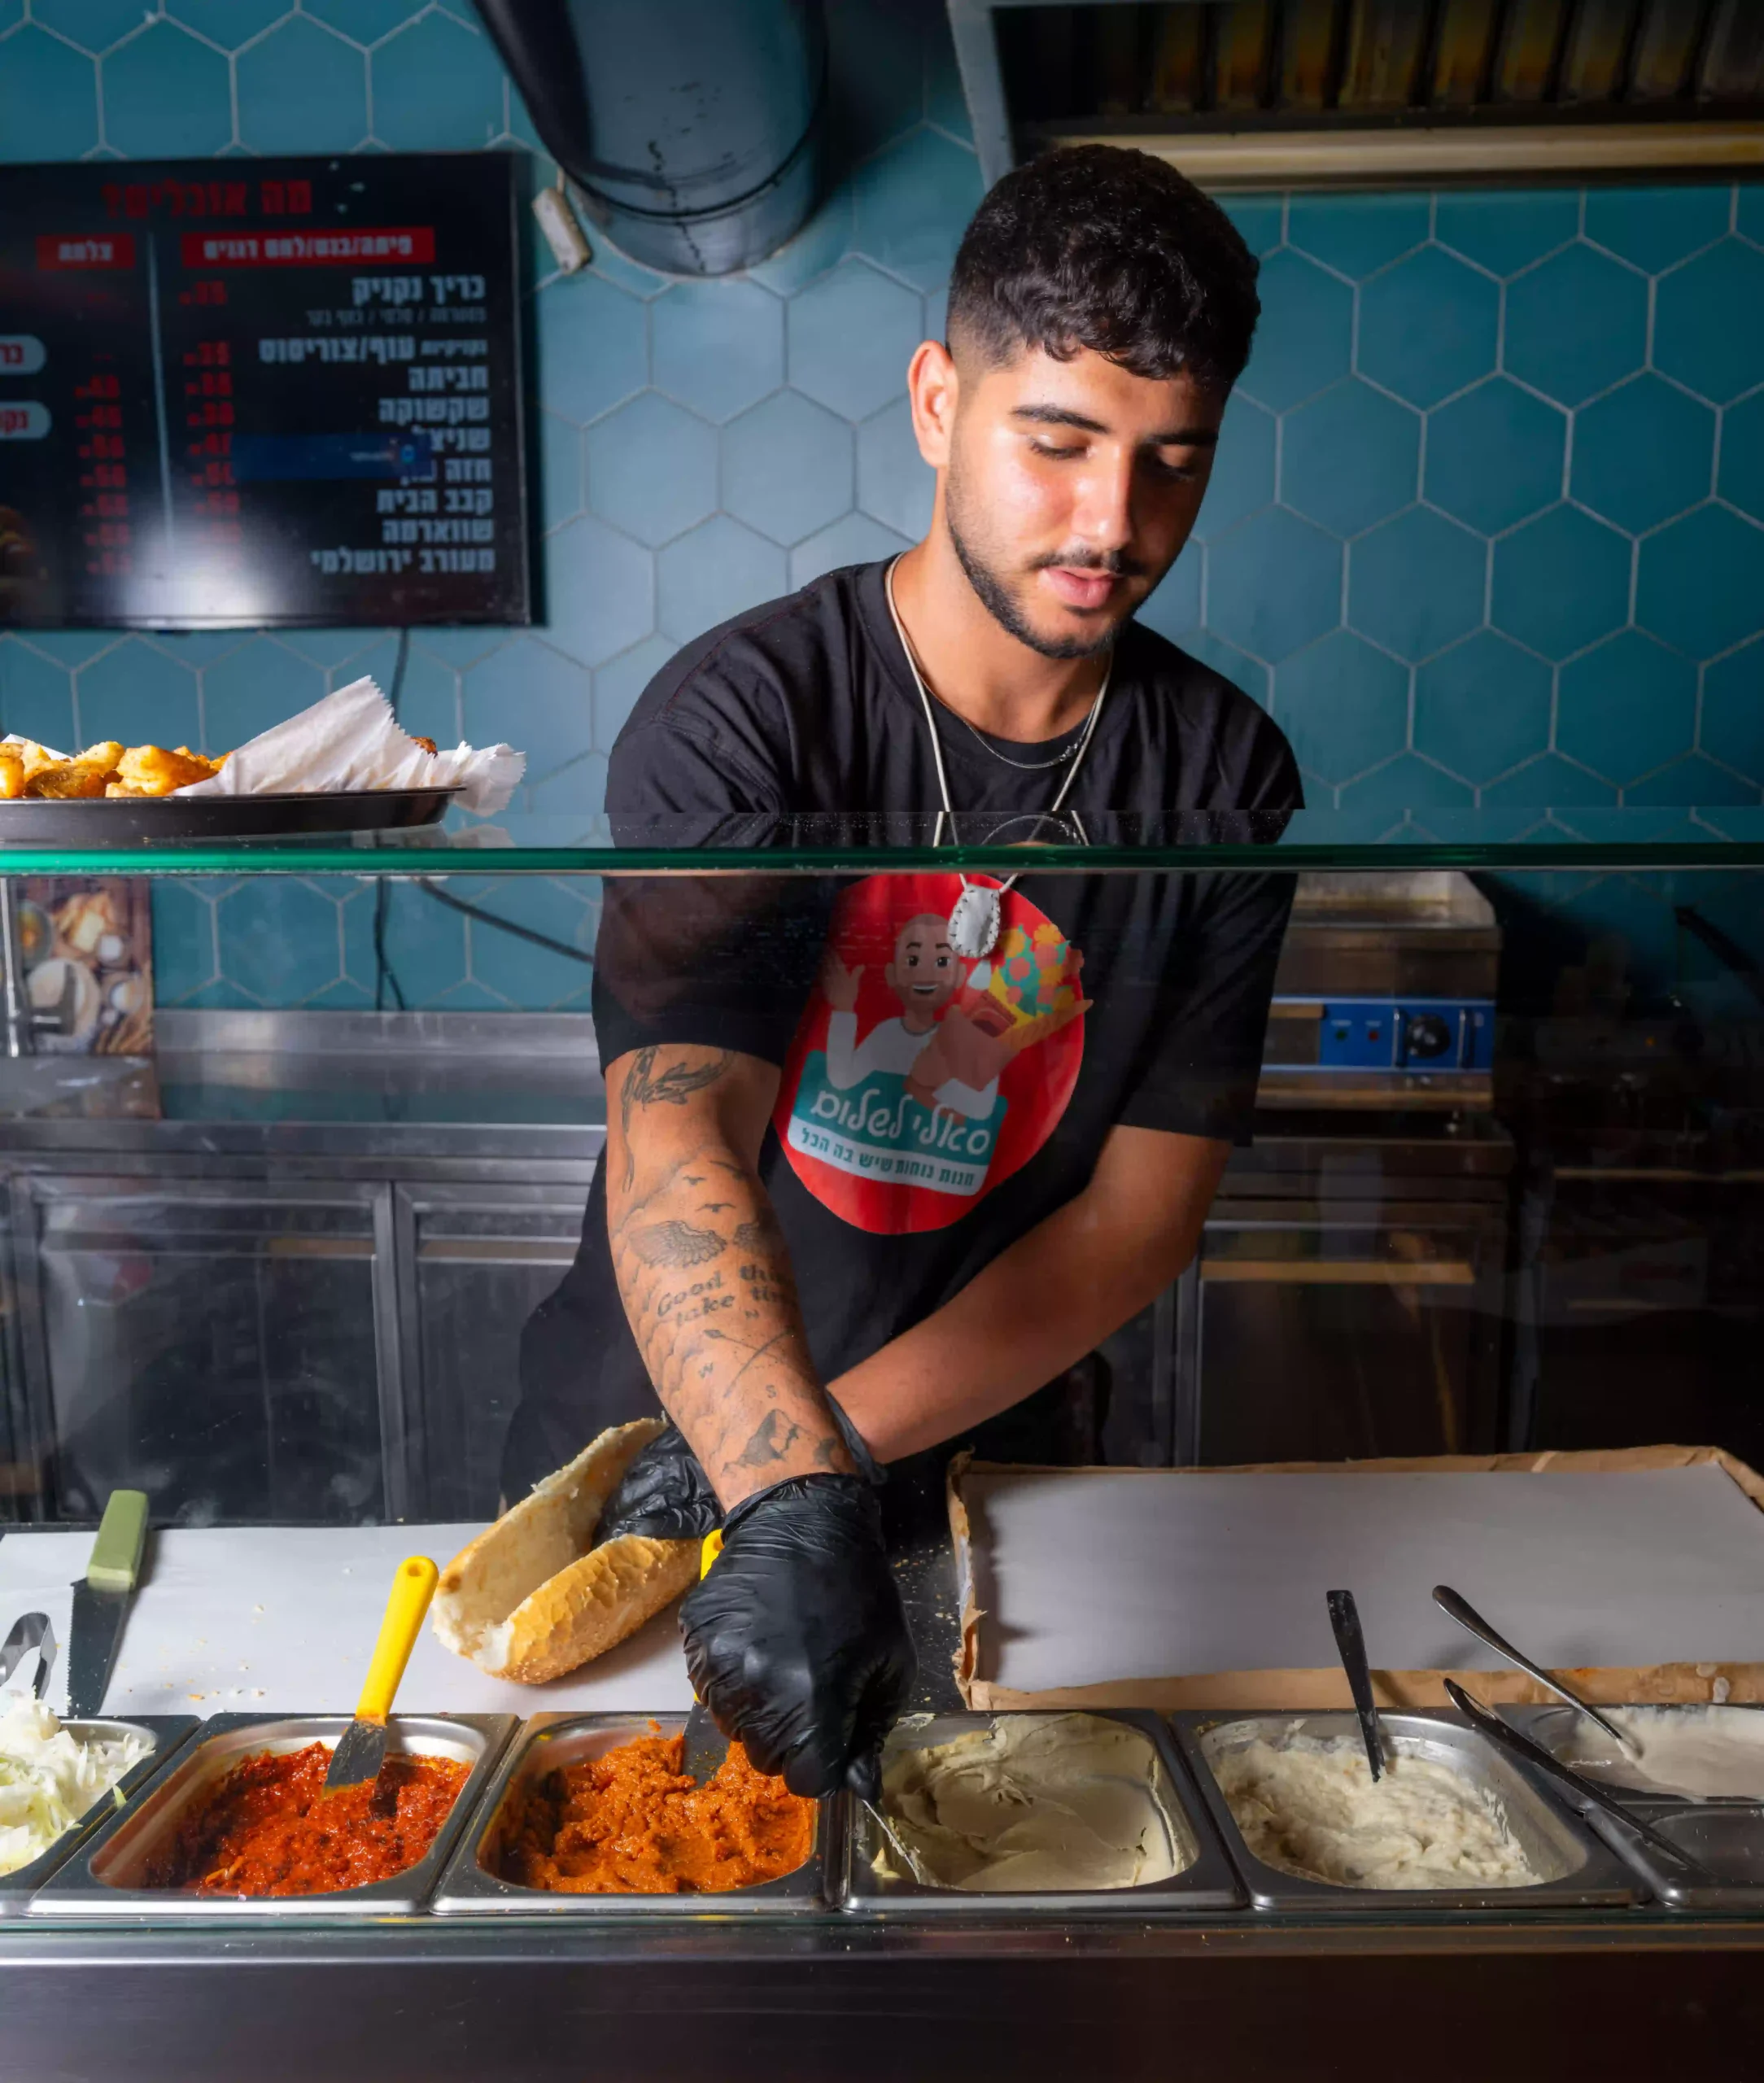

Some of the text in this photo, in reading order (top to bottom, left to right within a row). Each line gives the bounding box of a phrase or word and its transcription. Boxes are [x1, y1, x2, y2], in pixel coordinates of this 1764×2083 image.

[102, 179, 312, 218] מה אוכלים?
[351, 274, 487, 307] כריך נקניק
[408, 366, 489, 391] חביתה
[378, 396, 491, 426] שקשוקה
[411, 425, 491, 452] שניצ
[444, 457, 492, 483] חזה
[376, 488, 493, 516] קבב הבית
[382, 518, 496, 544] שווארמה
[310, 545, 496, 575] מעורב ירושלמי
[810, 1088, 913, 1139] לשלום
[801, 1126, 975, 1187] חנות נוחות שיש בה הכל
[657, 1270, 723, 1317] Good
